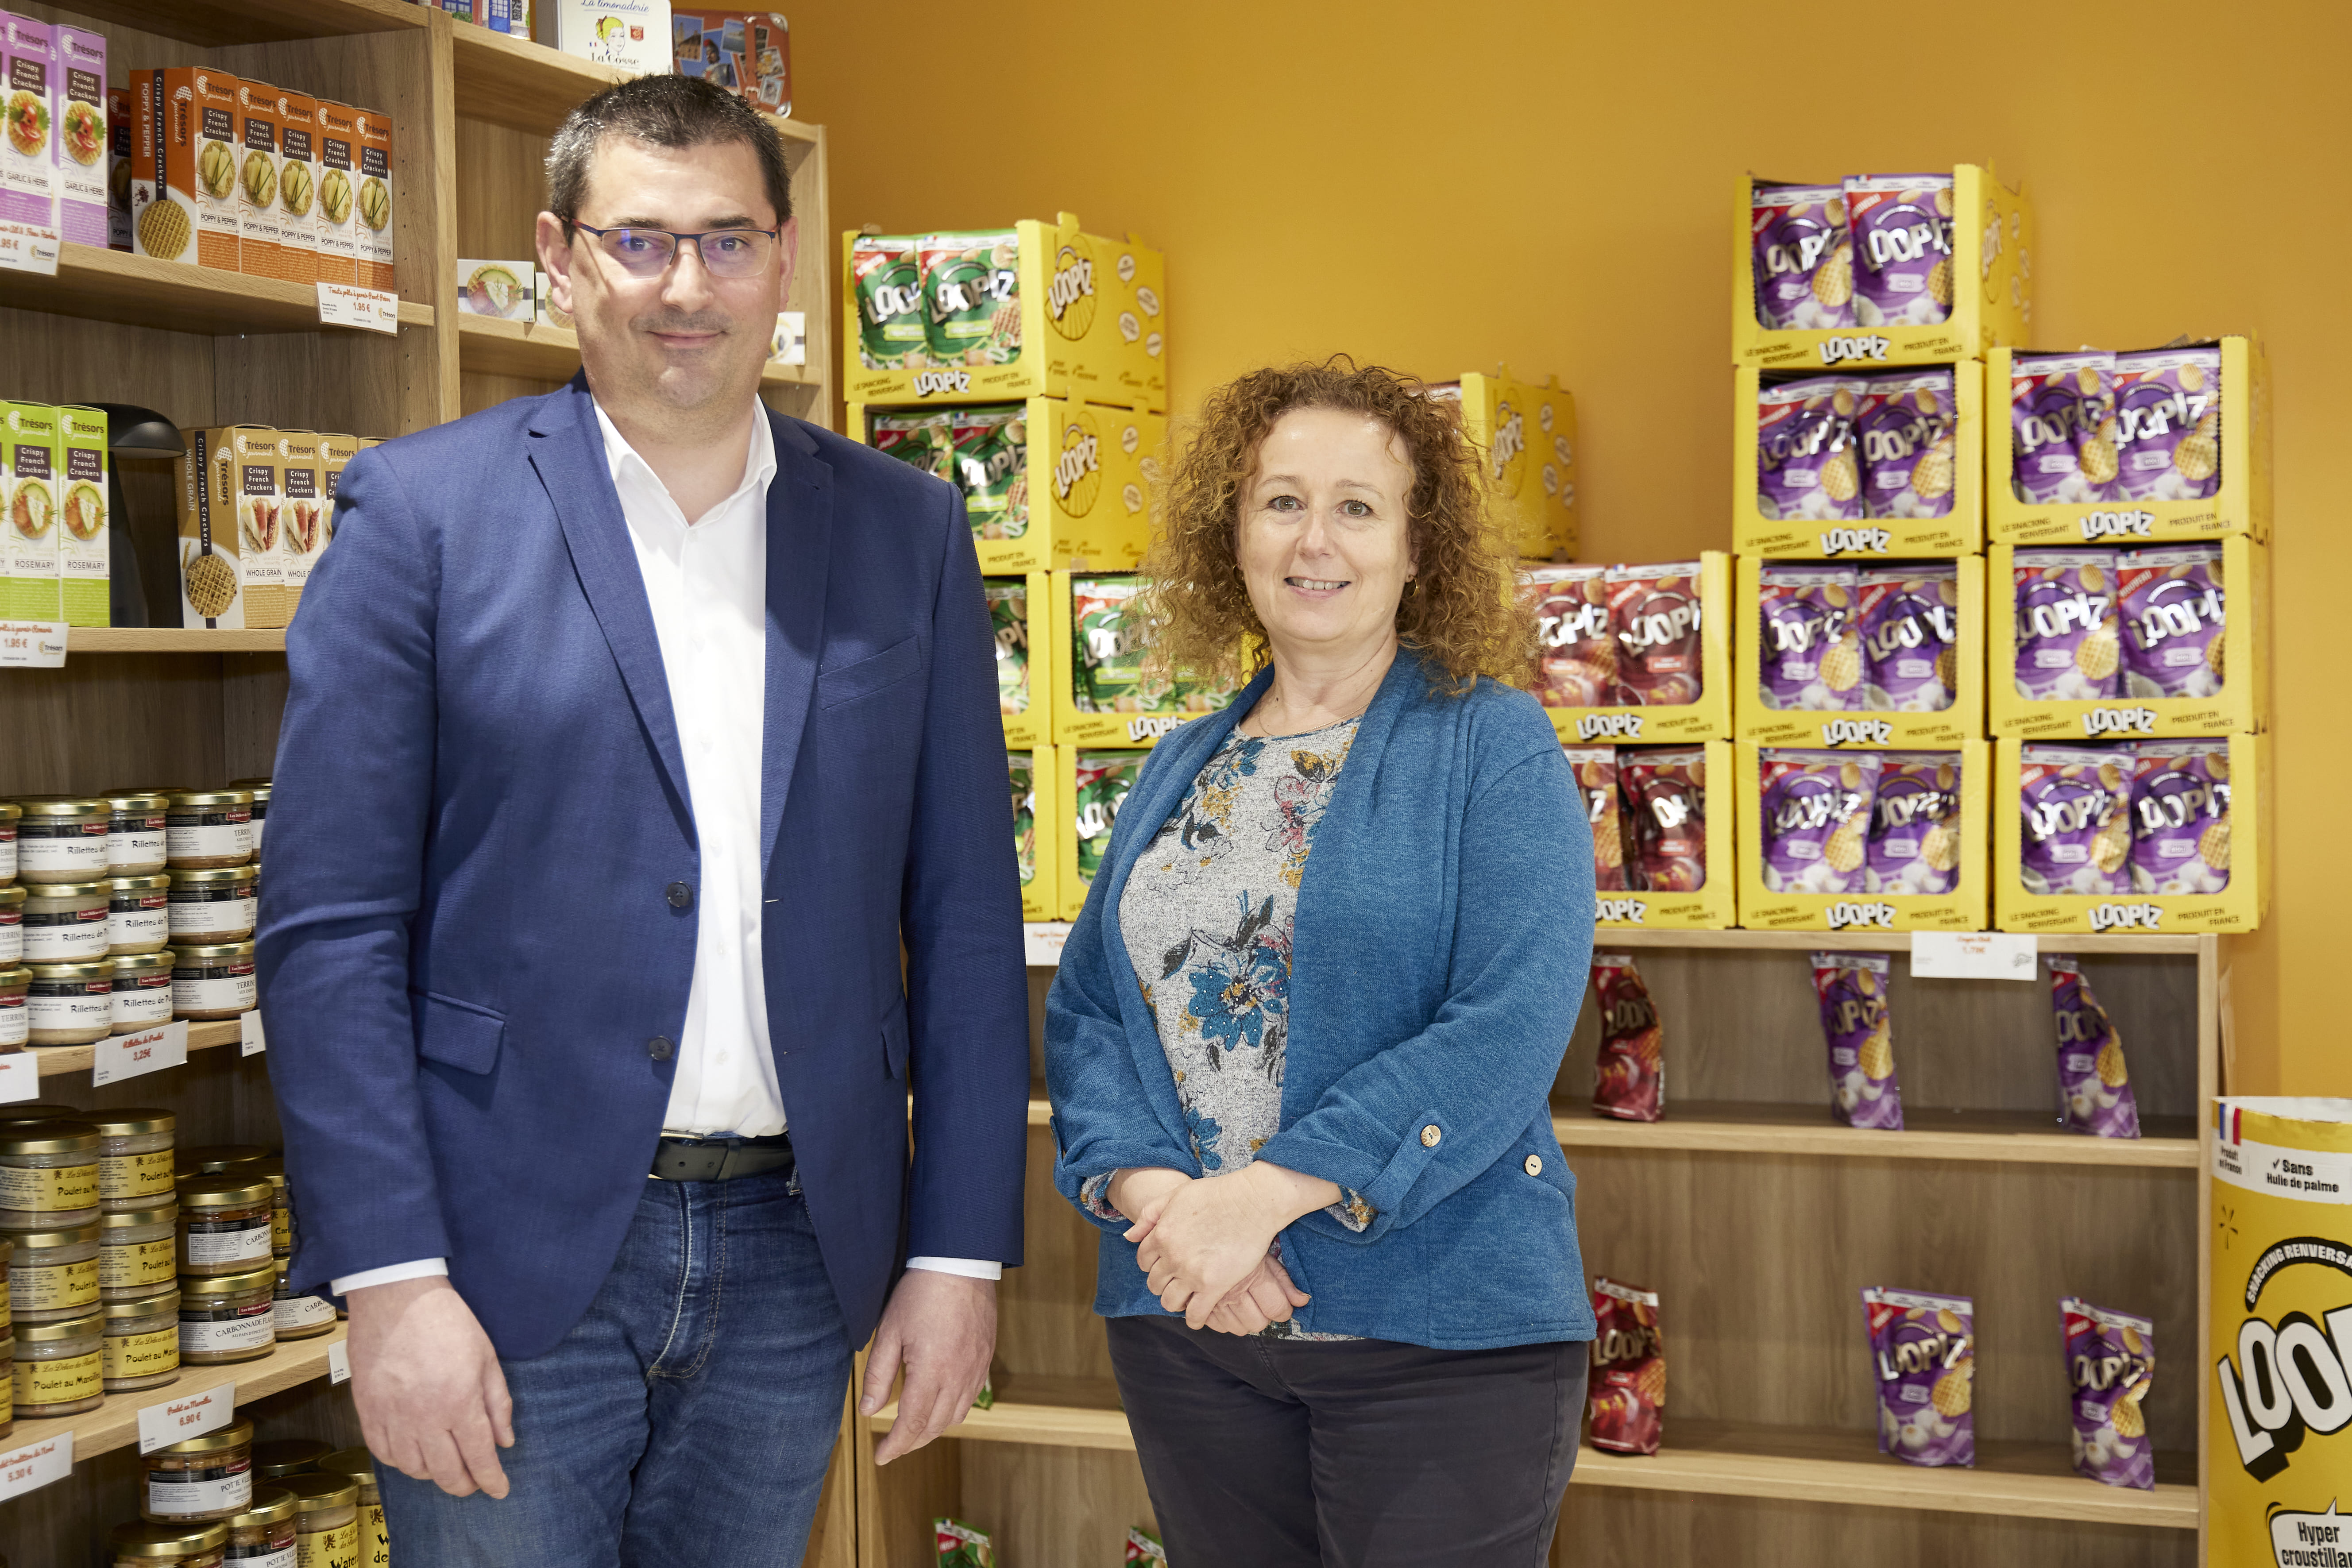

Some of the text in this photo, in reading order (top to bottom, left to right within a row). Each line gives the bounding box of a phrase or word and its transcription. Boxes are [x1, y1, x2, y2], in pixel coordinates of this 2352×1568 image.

[71, 42, 104, 58] Trésors
[73, 72, 95, 84] Crispy
[73, 81, 96, 92] French
[208, 83, 235, 97] Trésors
[70, 89, 99, 102] Crackers
[249, 94, 276, 107] Trésors
[209, 111, 227, 121] Crispy
[208, 119, 228, 128] French
[251, 121, 268, 131] Crispy
[205, 127, 231, 137] Crackers
[250, 129, 269, 138] French
[247, 137, 272, 147] Crackers
[65, 182, 84, 192] GARLIC
[89, 187, 104, 196] HERBS
[222, 217, 237, 226] PEPPER
[263, 226, 279, 234] PEPPER
[928, 269, 1015, 324] LOOPIZ
[353, 302, 371, 313] 1.95 €
[1819, 335, 1891, 365] LOOPIZ
[913, 369, 971, 397] LOOPIZ
[20, 418, 52, 430] Trésors
[72, 422, 104, 433] Trésors
[246, 442, 275, 450] Trésors
[288, 445, 316, 454] Trésors
[22, 448, 43, 457] Crispy
[74, 451, 95, 460] Crispy
[246, 448, 273, 459] gourmands
[288, 452, 313, 462] gourmands
[17, 466, 48, 475] Crackers
[70, 468, 100, 477] Crackers
[213, 460, 224, 502] gourmands
[2079, 510, 2156, 541] LOOPIZ
[2170, 515, 2205, 526] PRODUIT
[2201, 521, 2232, 531] FRANCE
[1820, 527, 1891, 557] LOOPIZ
[15, 560, 54, 569] ROSEMARY
[67, 561, 105, 570] ROSEMARY
[4, 638, 27, 648] 1.95 €
[1576, 713, 1644, 740] LOOPIZ
[2082, 707, 2158, 737] LOOPIZ
[1822, 719, 1893, 747] LOOPIZ
[67, 846, 98, 855] Rillettes
[132, 840, 159, 849] Rillettes
[1826, 902, 1897, 930] LOOPIZ
[2088, 903, 2164, 933] LOOPIZ
[2178, 910, 2213, 921] PRODUIT
[2209, 915, 2241, 927] FRANCE
[123, 999, 156, 1008] Rillettes
[134, 1048, 151, 1062] 3,25€
[2221, 1145, 2239, 1162] Produit
[2225, 1160, 2243, 1175] France
[2282, 1159, 2314, 1176] Sans
[140, 1173, 162, 1182] Poulet
[2267, 1173, 2340, 1193] Huile de palme
[57, 1187, 82, 1196] Poulet
[2247, 1243, 2352, 1303] SNACKING RENVERSA
[216, 1319, 262, 1337] CARBONNADE
[126, 1354, 151, 1363] Poulet
[33, 1381, 62, 1390] Poulet
[76, 1372, 100, 1385] Maroilles
[180, 1412, 201, 1426] 6.90 €
[8, 1465, 32, 1483] 5.30 €
[2298, 1522, 2340, 1546] Hyper
[374, 1550, 388, 1563] de
[2282, 1548, 2352, 1568] croustilla
